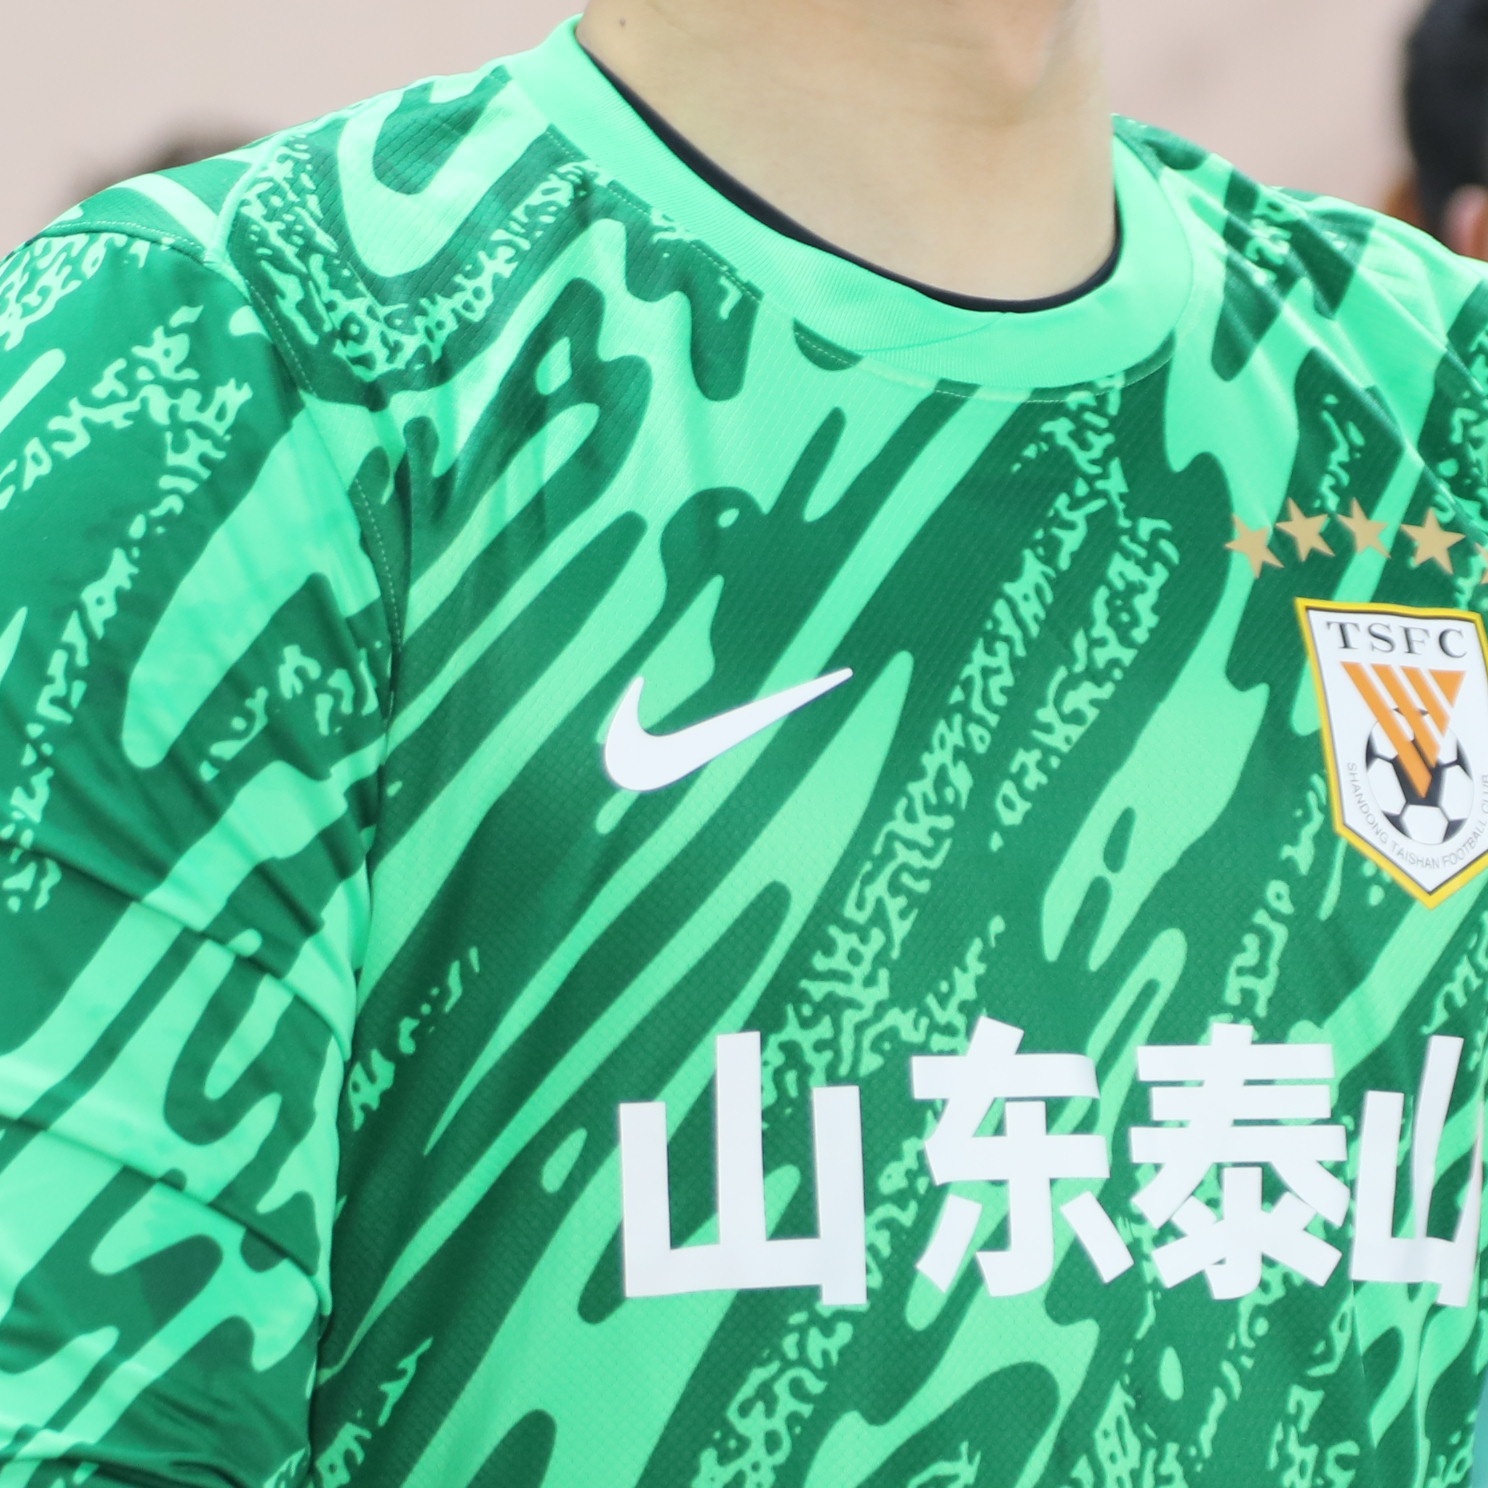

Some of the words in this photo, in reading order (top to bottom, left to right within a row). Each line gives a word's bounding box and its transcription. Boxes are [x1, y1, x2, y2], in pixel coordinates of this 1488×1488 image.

[1326, 620, 1468, 659] TSFC
[1347, 762, 1390, 844] SHANDONG
[1390, 839, 1440, 870] TAISHAN
[1442, 818, 1488, 869] FOOTBALL
[619, 1016, 1482, 1306] 山东泰山
